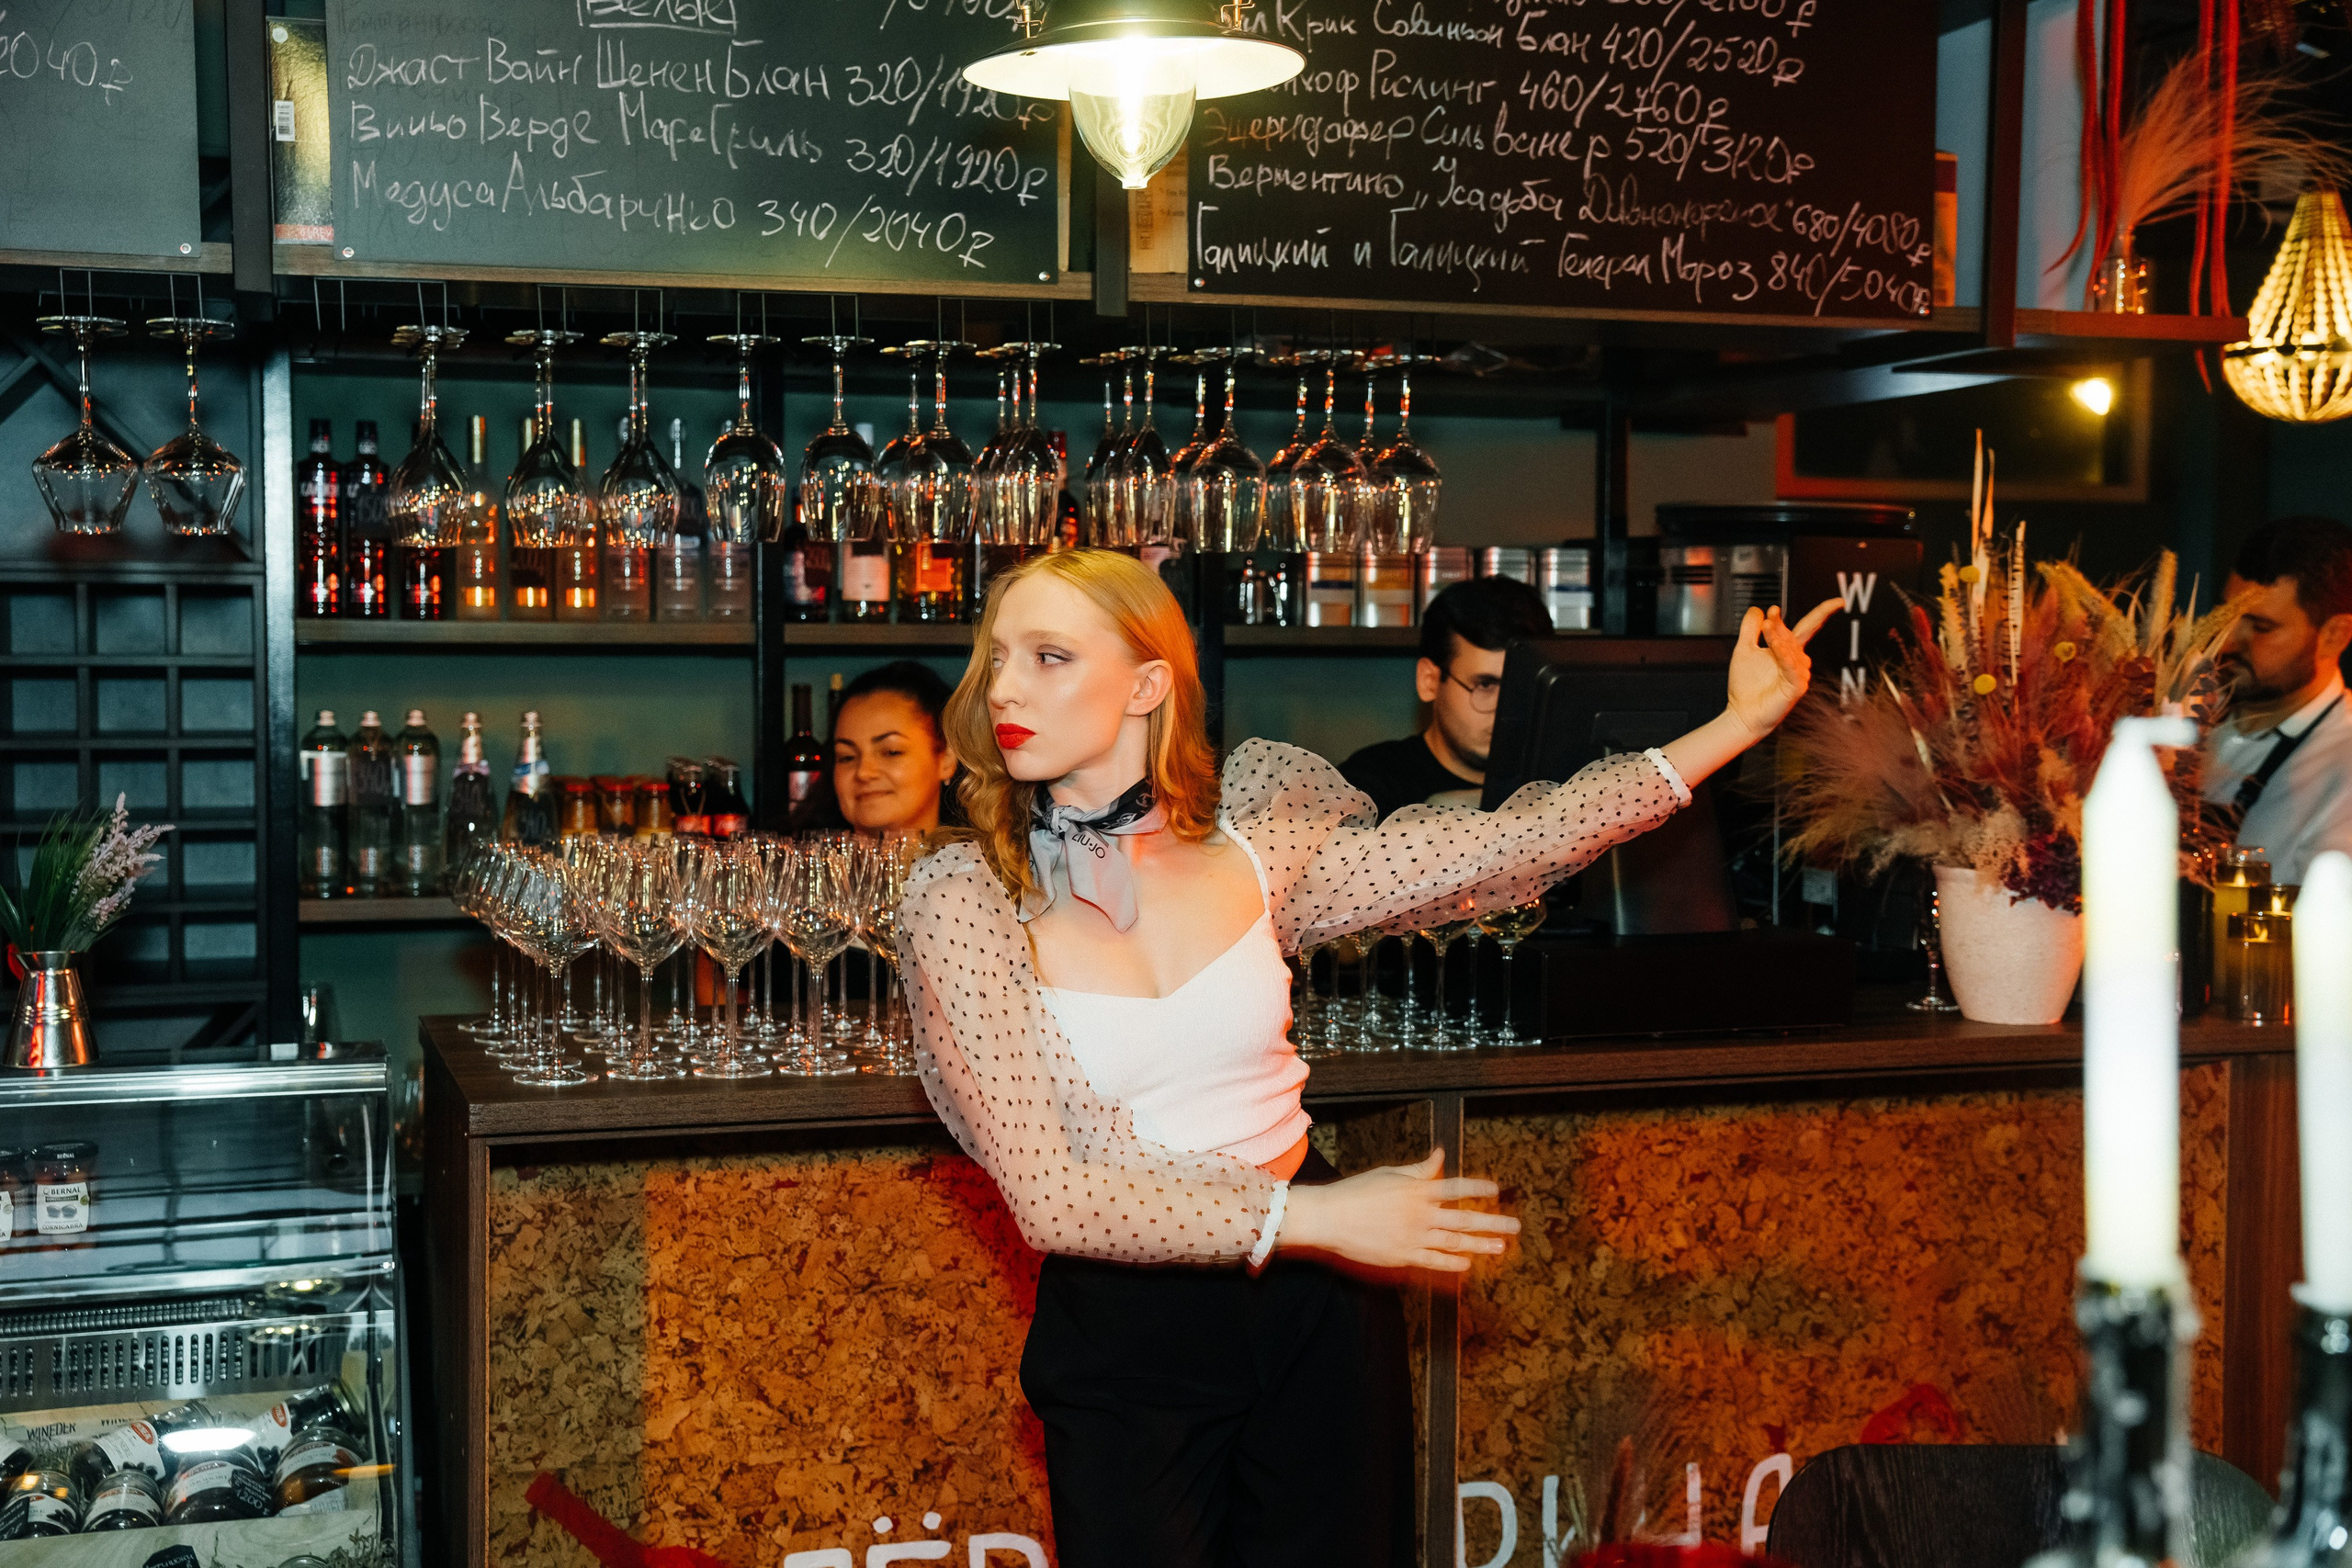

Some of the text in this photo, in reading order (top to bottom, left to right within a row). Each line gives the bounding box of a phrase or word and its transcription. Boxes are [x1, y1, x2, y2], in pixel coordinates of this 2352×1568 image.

[1515, 8, 1591, 63] Блан
[347, 42, 481, 89] Джаст
[725, 39, 831, 100] Блан
[1370, 48, 1498, 105] Рислинг
[479, 93, 600, 159] Верде
[352, 159, 496, 231] Медуса
[1195, 200, 1329, 275] Галицкий
[1353, 240, 1373, 269] и
[1389, 206, 1546, 293] Галицкий
[1660, 231, 1759, 304] Мороз
[51, 1186, 81, 1195] BERNAL
